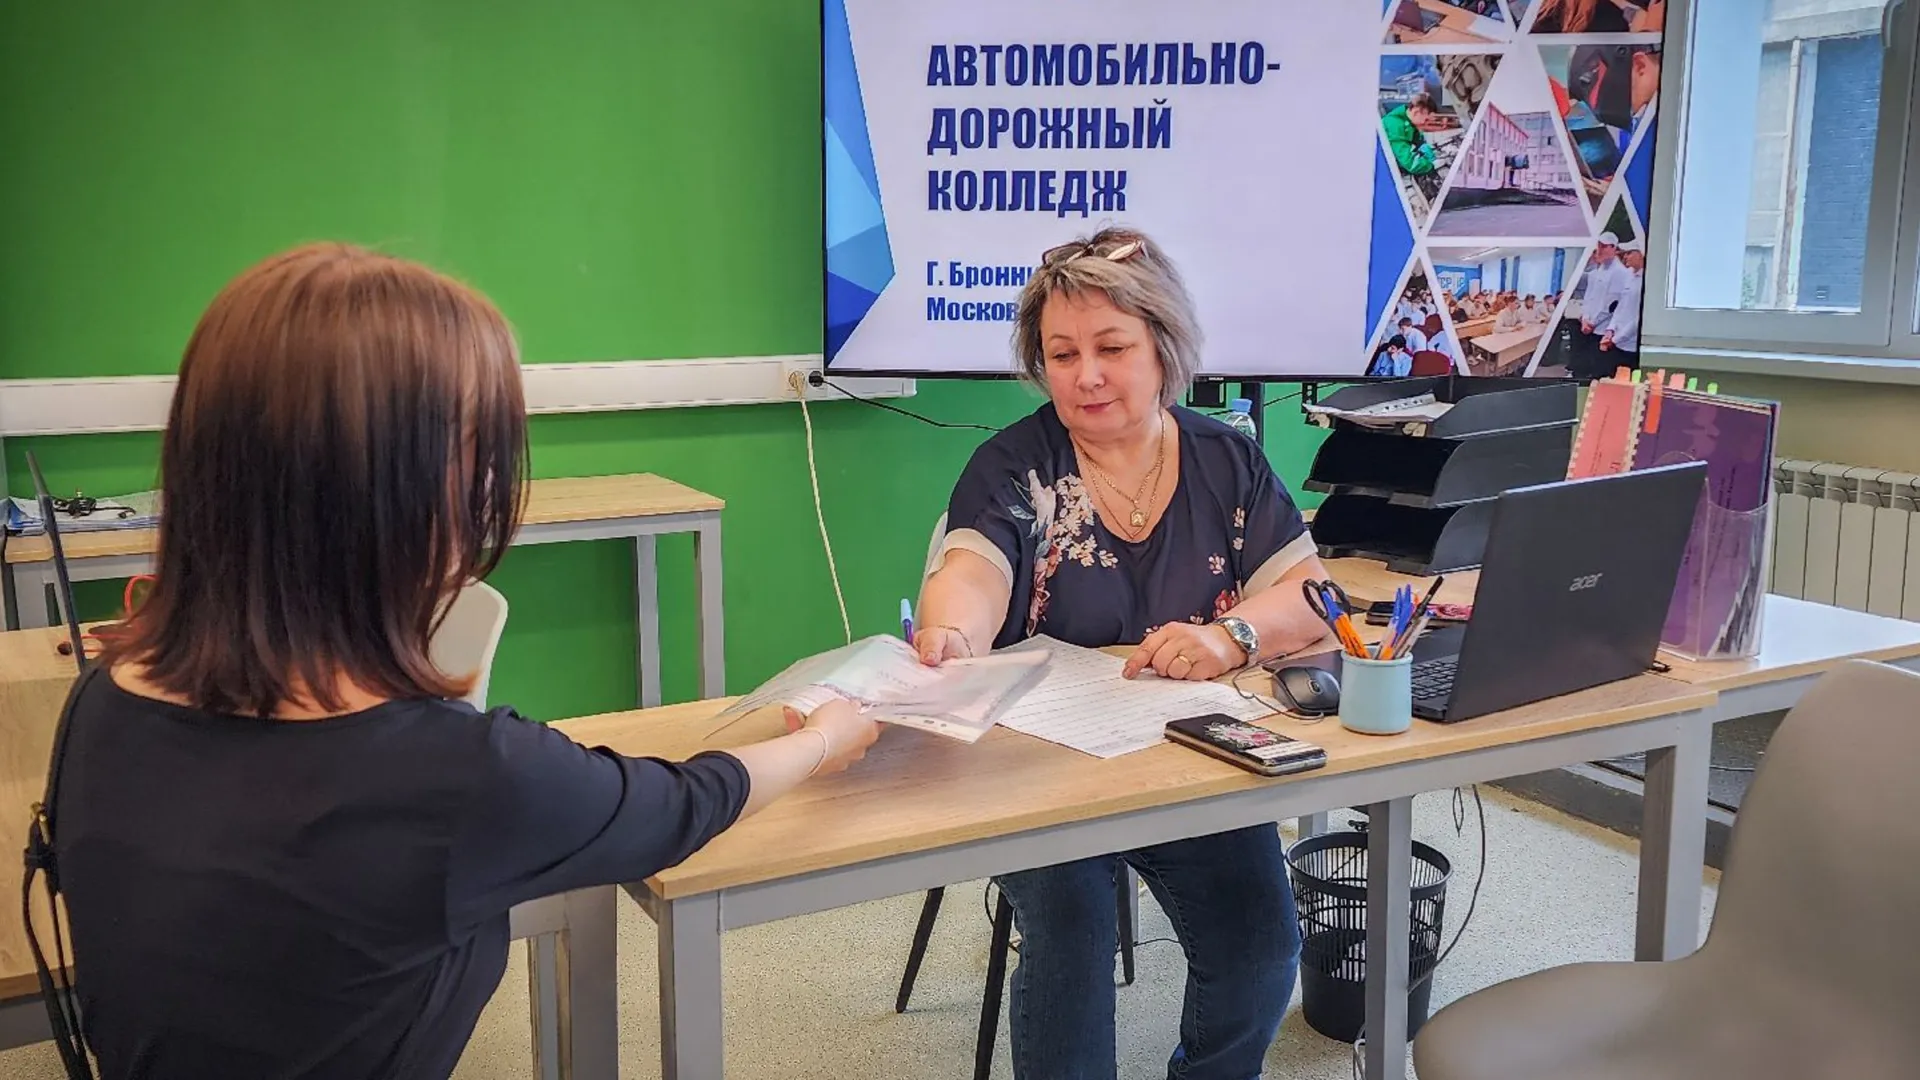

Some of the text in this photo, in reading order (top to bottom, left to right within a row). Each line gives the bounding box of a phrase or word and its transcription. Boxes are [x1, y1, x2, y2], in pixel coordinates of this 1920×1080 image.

[926, 41, 1281, 87] АВТОМОБИЛЬНО-
[926, 98, 1172, 155] ДОРОЖНЫЙ
[926, 170, 1127, 218] КОЛЛЕДЖ
[926, 261, 944, 286] Г.
[1569, 572, 1603, 592] acer
